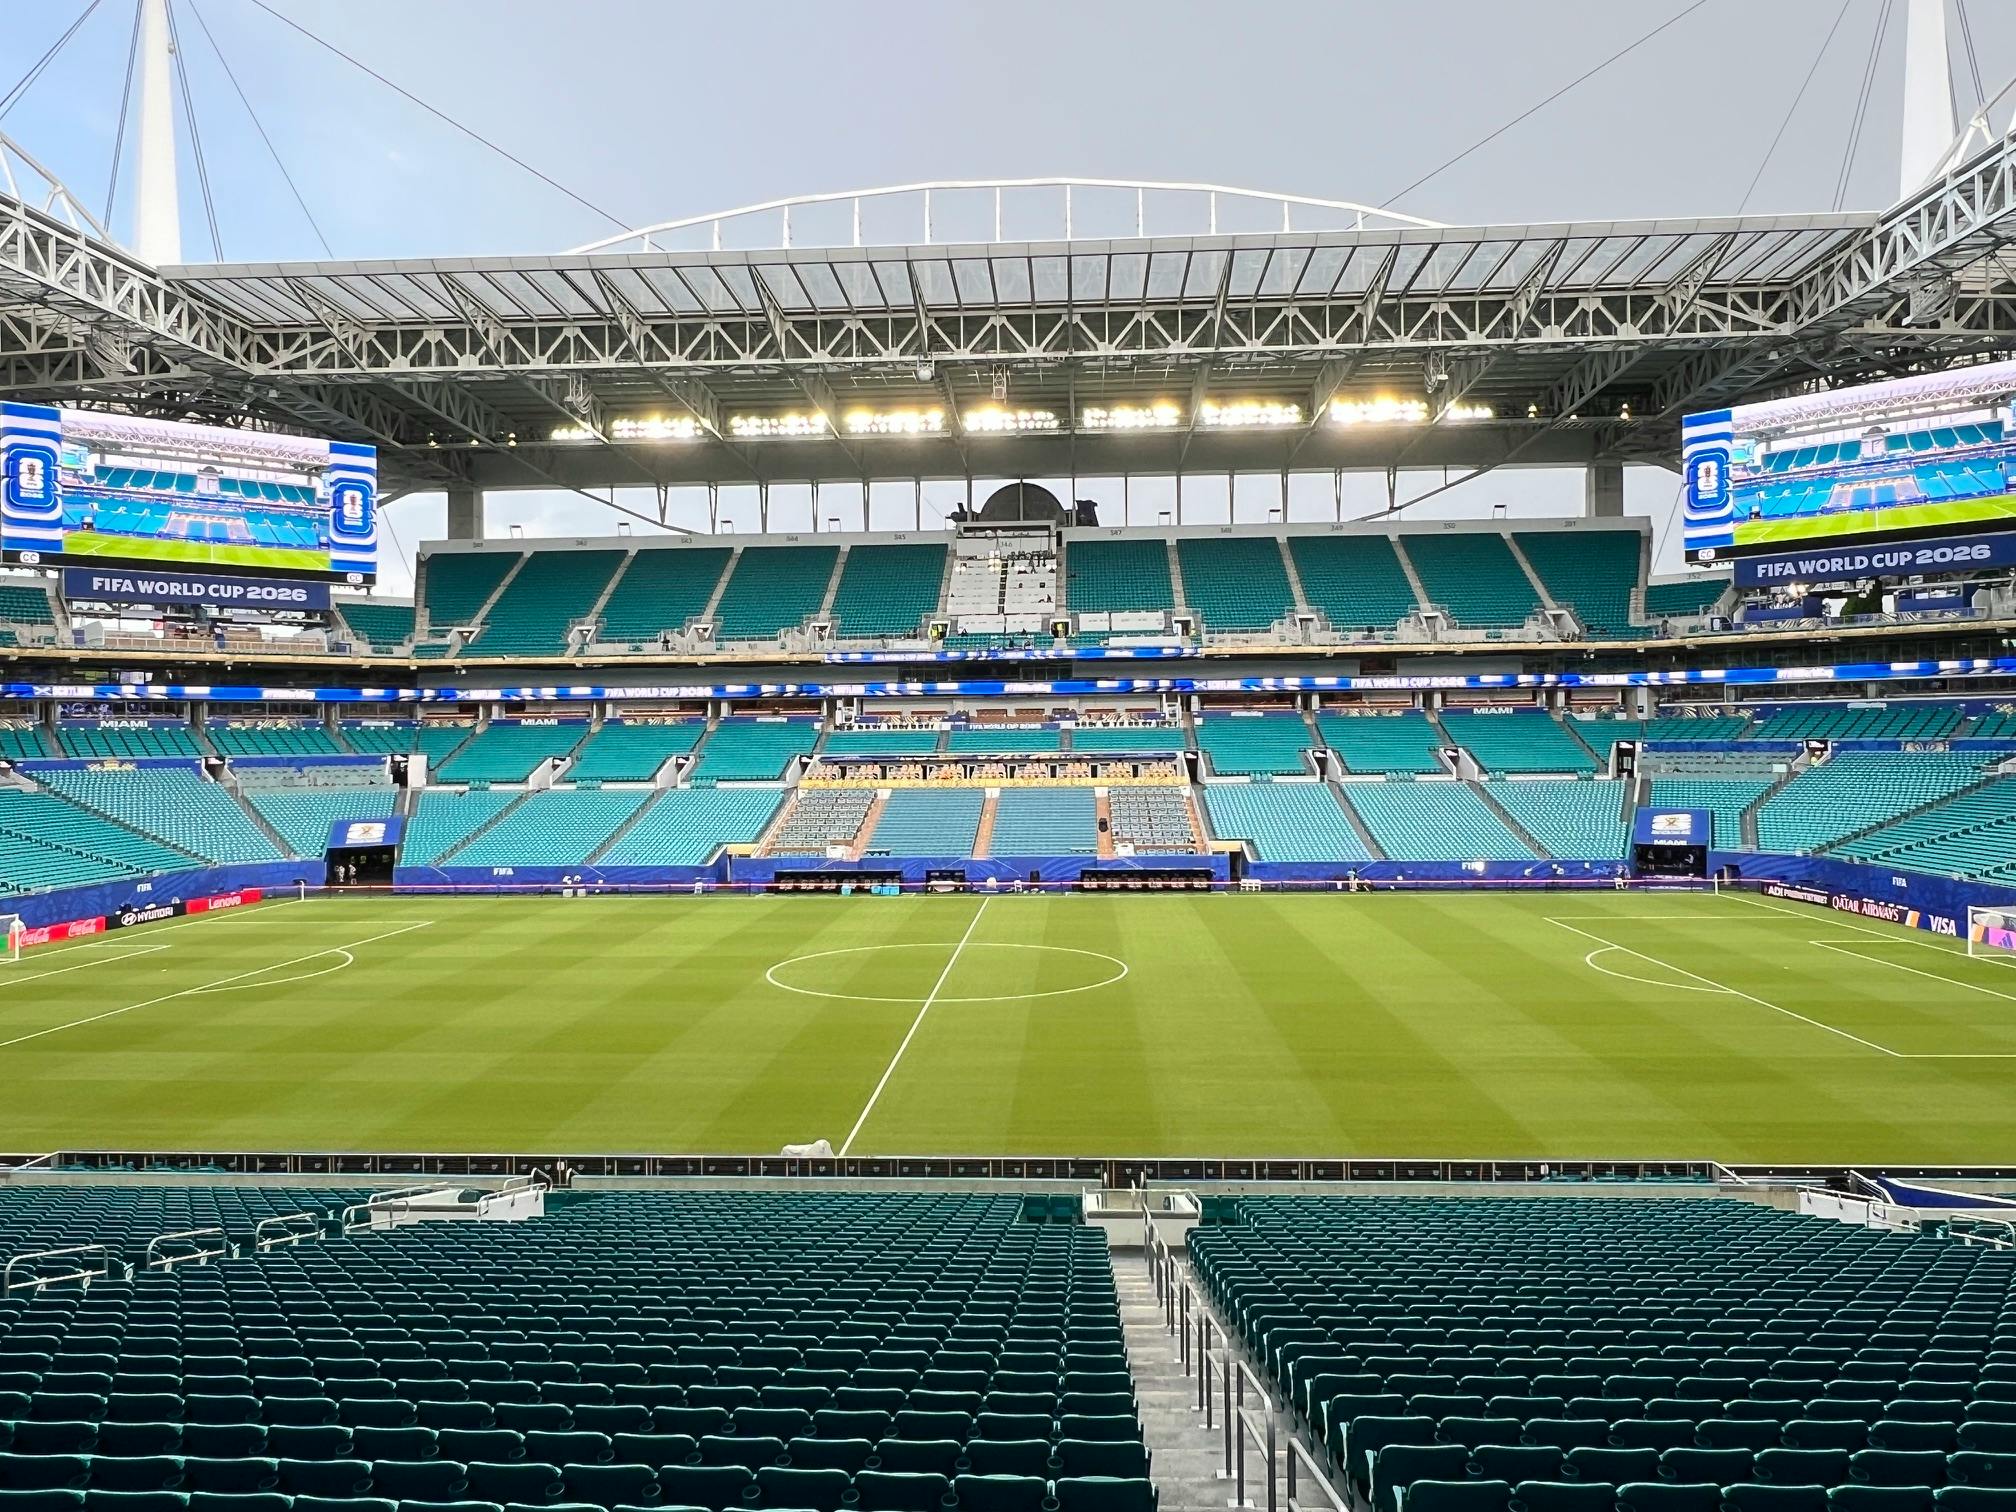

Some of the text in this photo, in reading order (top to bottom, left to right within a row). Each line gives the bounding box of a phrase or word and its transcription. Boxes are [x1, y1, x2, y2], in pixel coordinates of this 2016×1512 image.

[1757, 544, 1991, 578] FIFA WORLD CUP 2026
[92, 576, 308, 602] FIFA WORLD CUP 2026
[1472, 706, 1514, 715] MIAMI
[100, 720, 148, 728] MIAMI
[520, 718, 558, 726] MIAMI
[493, 867, 514, 876] FIFA
[1892, 876, 1908, 888] FIFA
[1768, 886, 1784, 897] ADI
[208, 895, 242, 910] Lenovo
[1832, 896, 1899, 922] QATAR AIRWAYS
[137, 906, 174, 922] HYUNDAI
[1928, 914, 1957, 937] VISA
